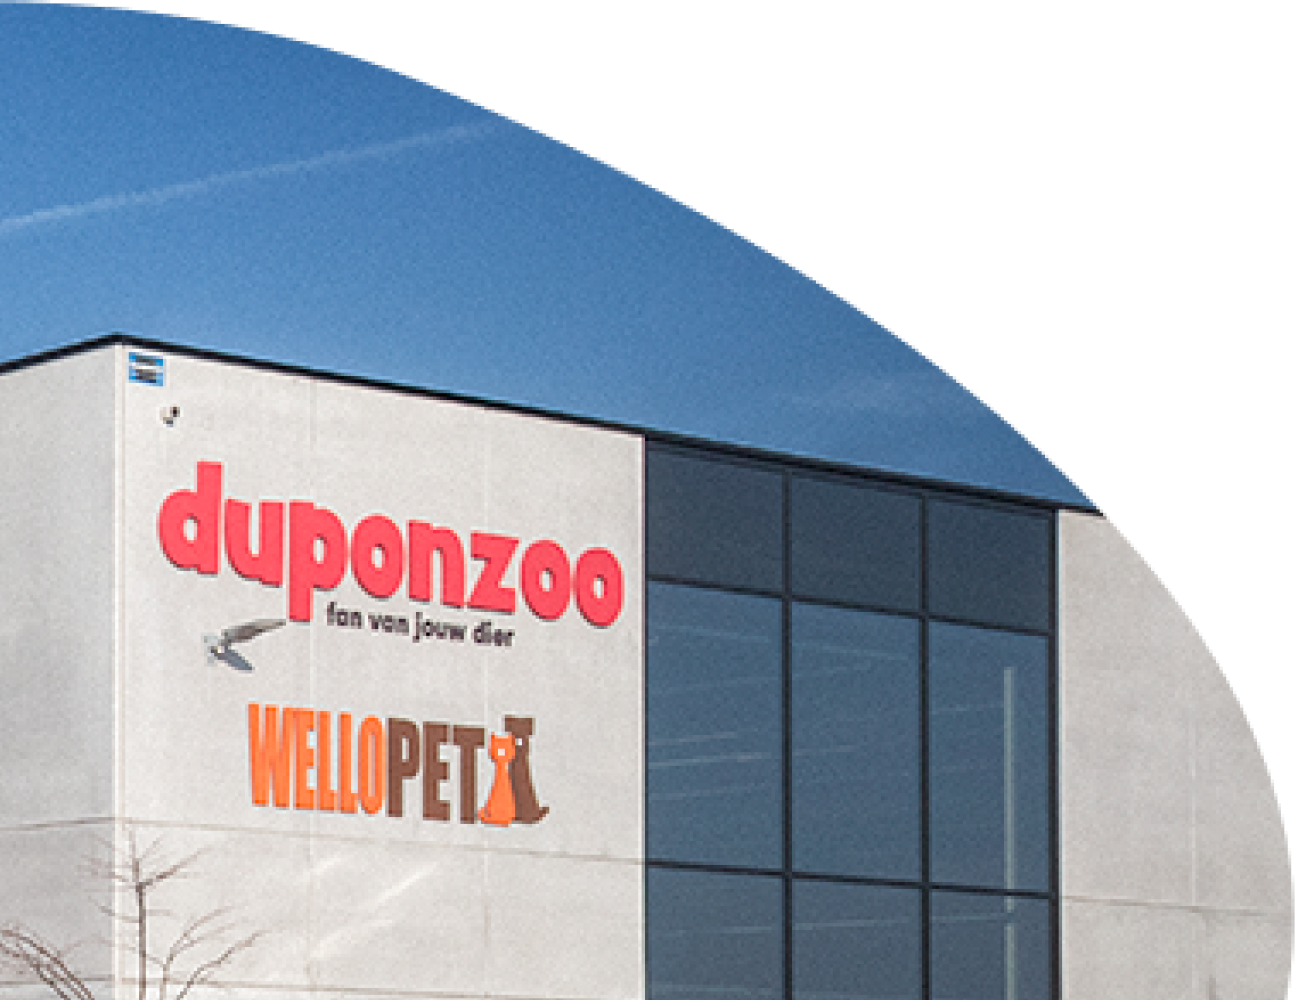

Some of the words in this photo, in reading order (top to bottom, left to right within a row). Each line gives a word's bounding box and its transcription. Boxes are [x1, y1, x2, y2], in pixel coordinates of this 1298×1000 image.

[158, 460, 625, 629] duponzoo
[326, 601, 362, 630] fan
[368, 611, 410, 637] van
[412, 611, 468, 644] jouw
[473, 621, 516, 647] dier
[247, 702, 487, 825] WELLOPET
